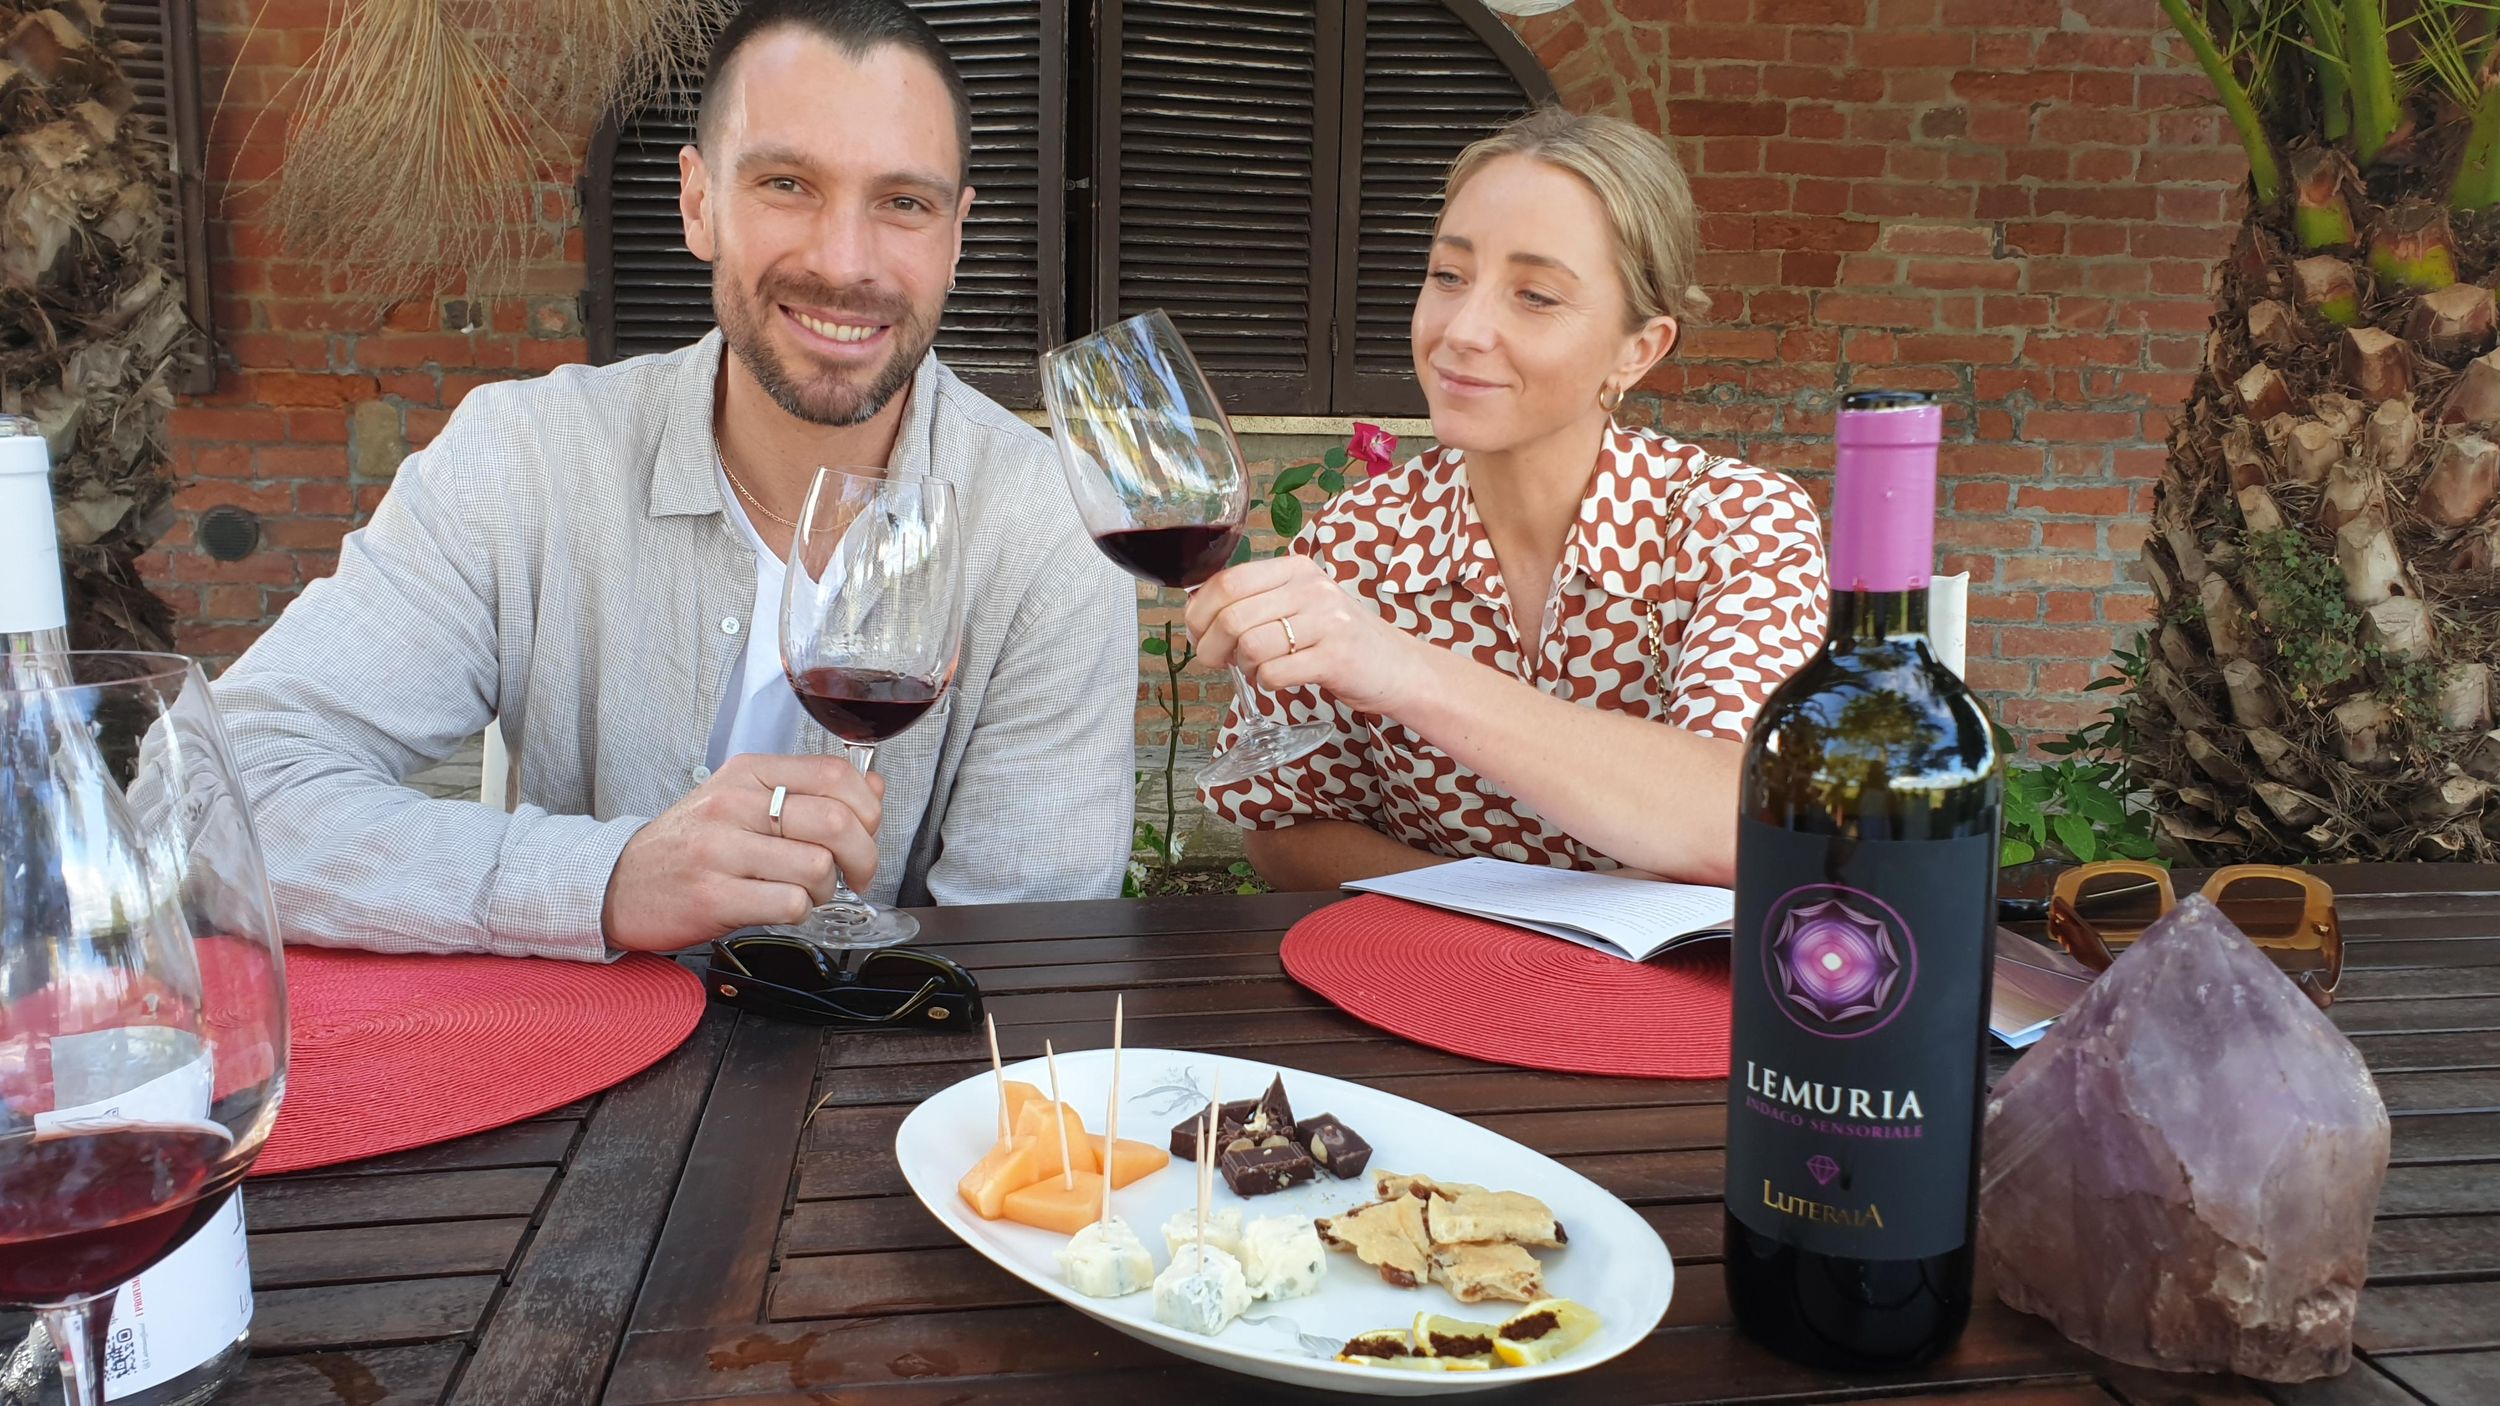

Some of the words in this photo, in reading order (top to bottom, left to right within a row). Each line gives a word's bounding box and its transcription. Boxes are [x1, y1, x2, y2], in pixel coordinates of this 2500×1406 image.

[1747, 1060, 1924, 1120] LEMURIA
[1746, 1096, 1804, 1126] INDACO
[1809, 1118, 1924, 1139] SENSORIALE
